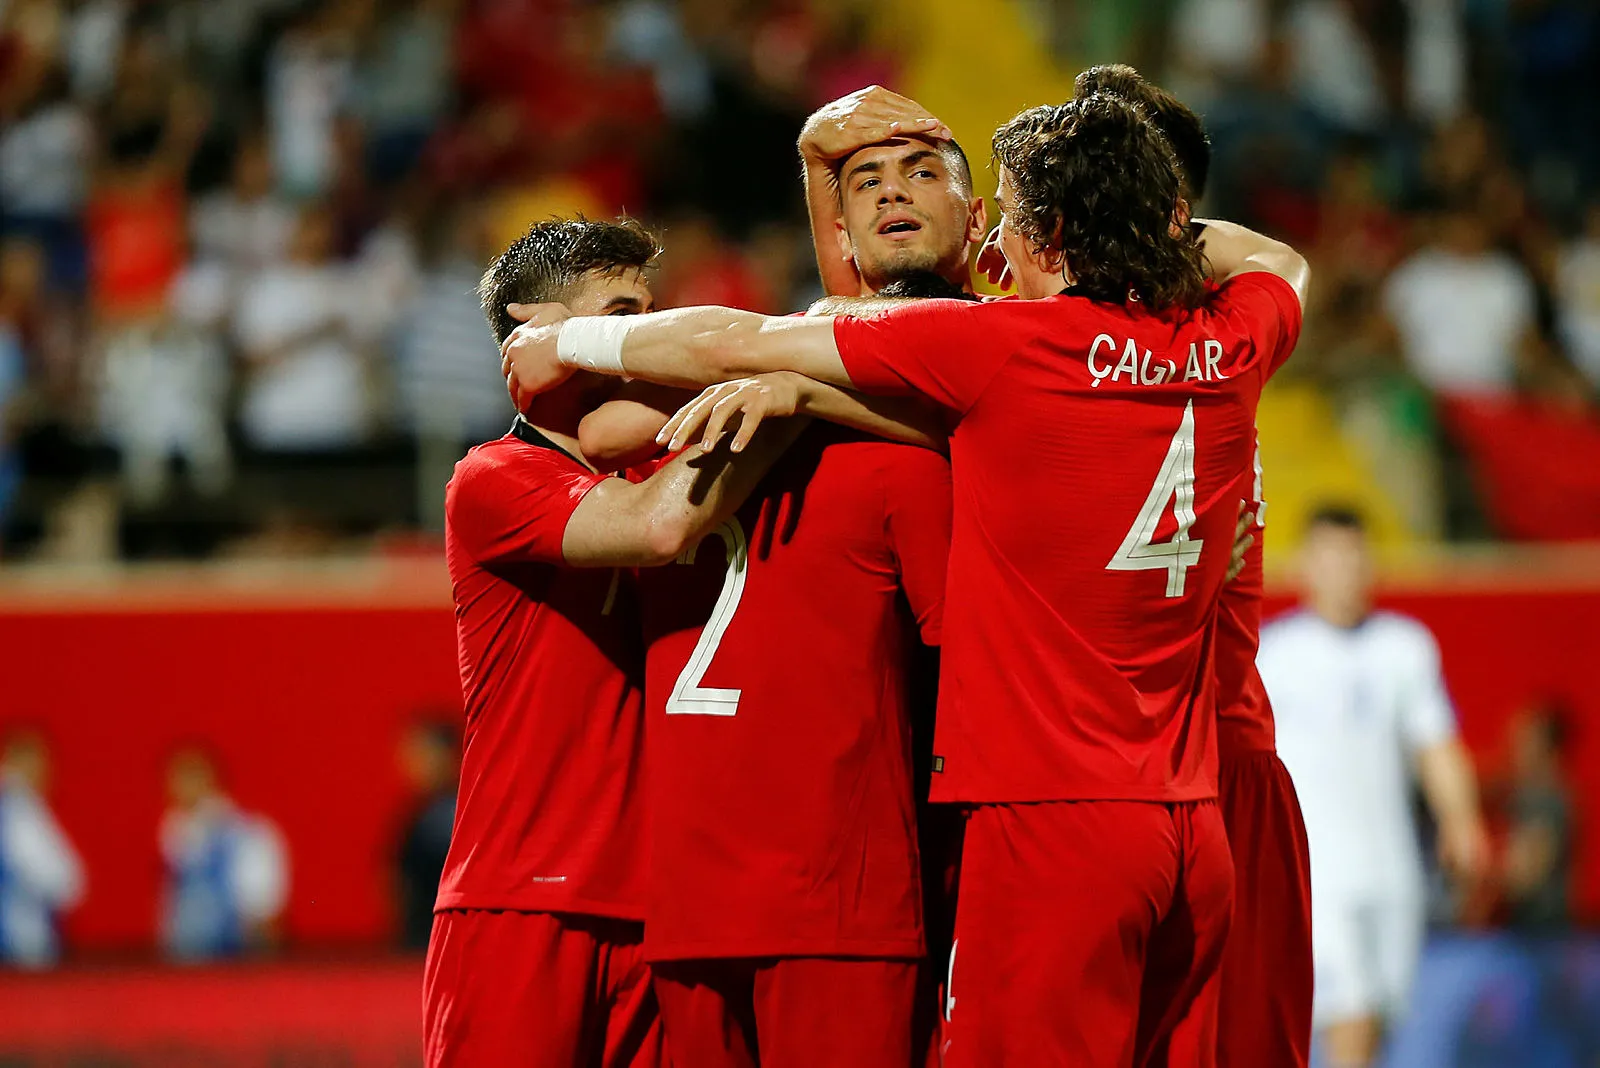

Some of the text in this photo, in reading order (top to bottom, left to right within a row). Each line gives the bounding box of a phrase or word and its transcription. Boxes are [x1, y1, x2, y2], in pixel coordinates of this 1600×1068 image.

[1087, 333, 1230, 388] ÇAGAR
[1105, 397, 1204, 598] 4
[665, 514, 748, 716] 2
